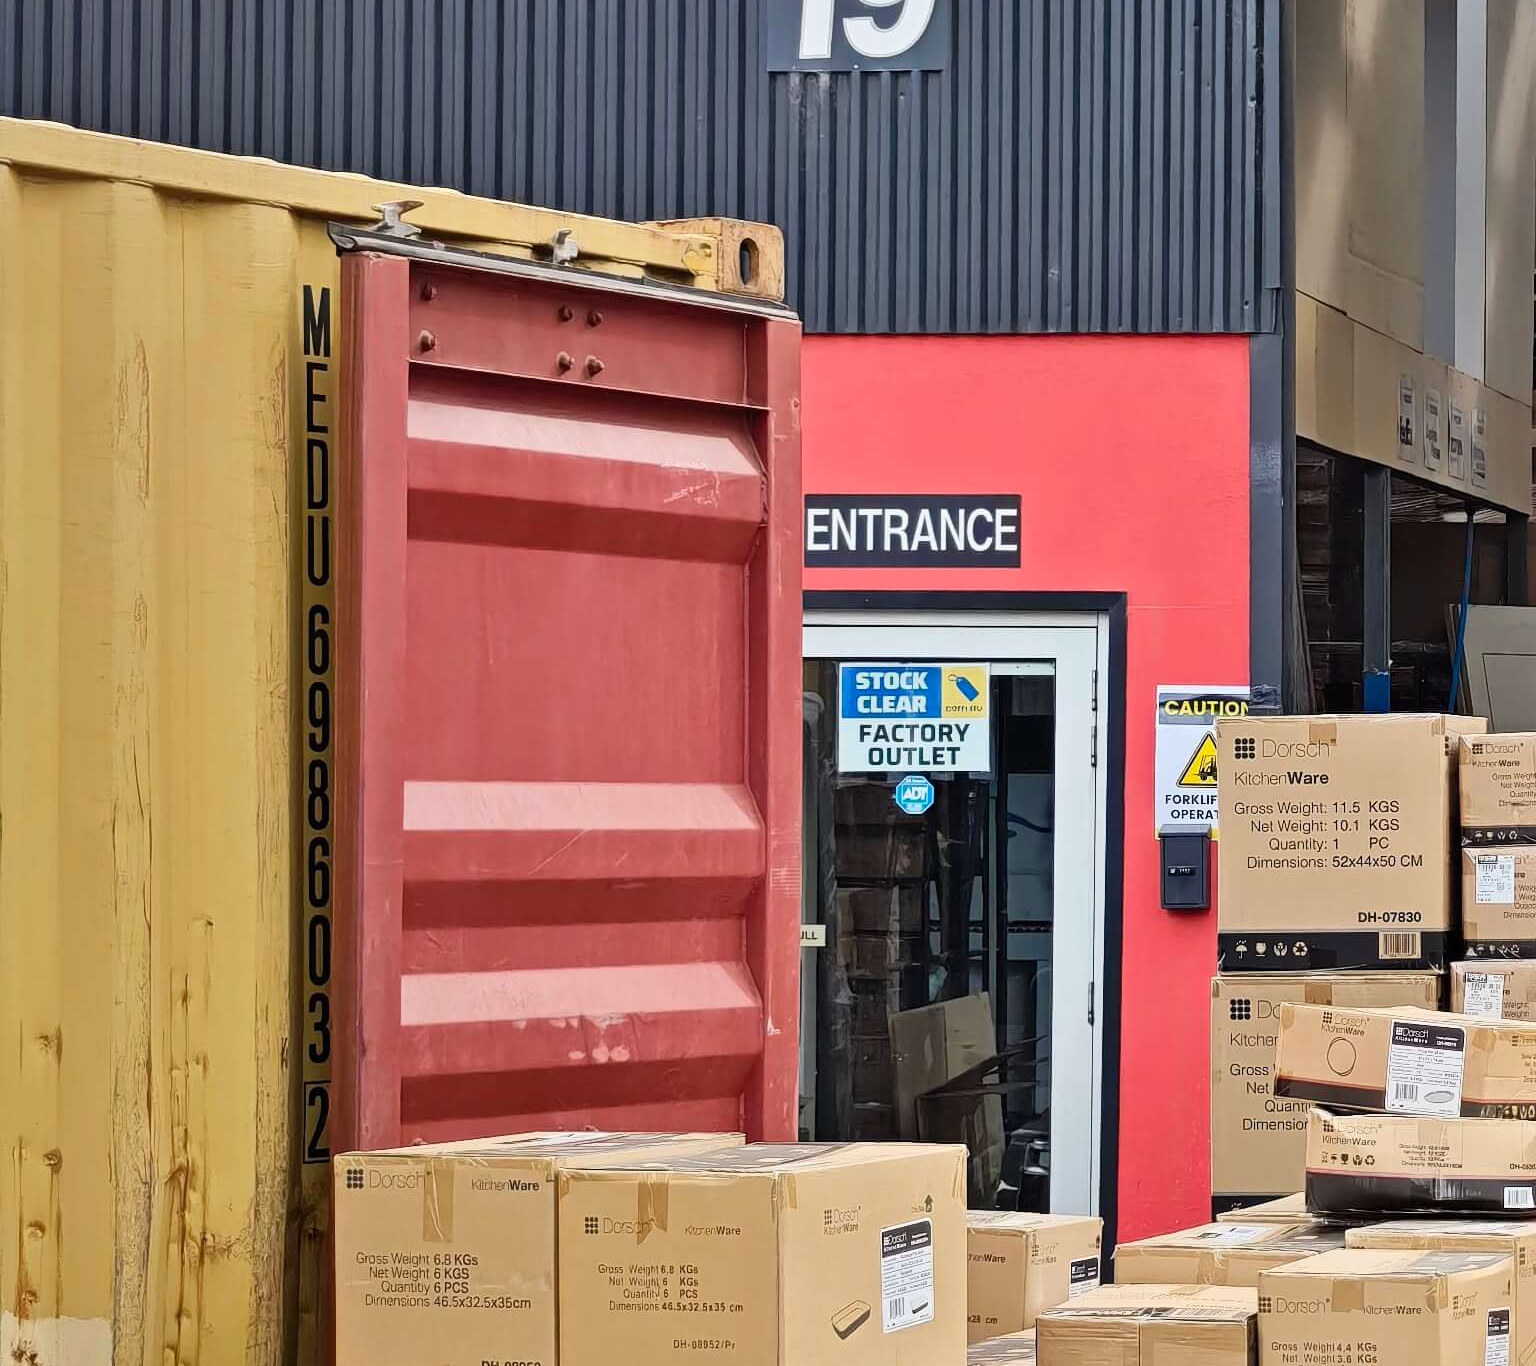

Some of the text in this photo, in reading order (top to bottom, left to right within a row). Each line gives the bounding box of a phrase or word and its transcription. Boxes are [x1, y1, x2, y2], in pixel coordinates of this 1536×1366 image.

[302, 284, 331, 587] MEDU
[807, 509, 1018, 551] ENTRANCE
[856, 672, 928, 689] STOCK
[857, 696, 926, 713] CLEAR
[859, 724, 970, 742] FACTORY
[868, 747, 960, 765] OUTLET
[1262, 739, 1331, 758] Dorsch
[1234, 771, 1329, 785] KitchenWare
[903, 787, 928, 800] ADT
[1165, 795, 1217, 804] FORKLIF
[1234, 801, 1399, 816] Gross Weight: 11.5 KGS
[1251, 819, 1400, 834] Net Weight: 10.1 KGS
[1269, 837, 1389, 852] Quantity: 1 PC
[1247, 855, 1423, 868] Dimensions: 52x44x50 CM
[1358, 912, 1422, 923] DH-07830
[472, 1180, 539, 1191] KitchenWare
[356, 1252, 478, 1267] Gross Weight 6.8 KGs
[369, 1267, 469, 1281] Net Weight 6 KGS
[434, 1282, 440, 1293] 6
[445, 1282, 469, 1293] PCS
[366, 1295, 429, 1306] Dimensions
[1272, 1342, 1297, 1351] Gross
[1304, 1343, 1335, 1353] Weight
[1358, 1343, 1377, 1351] KGs
